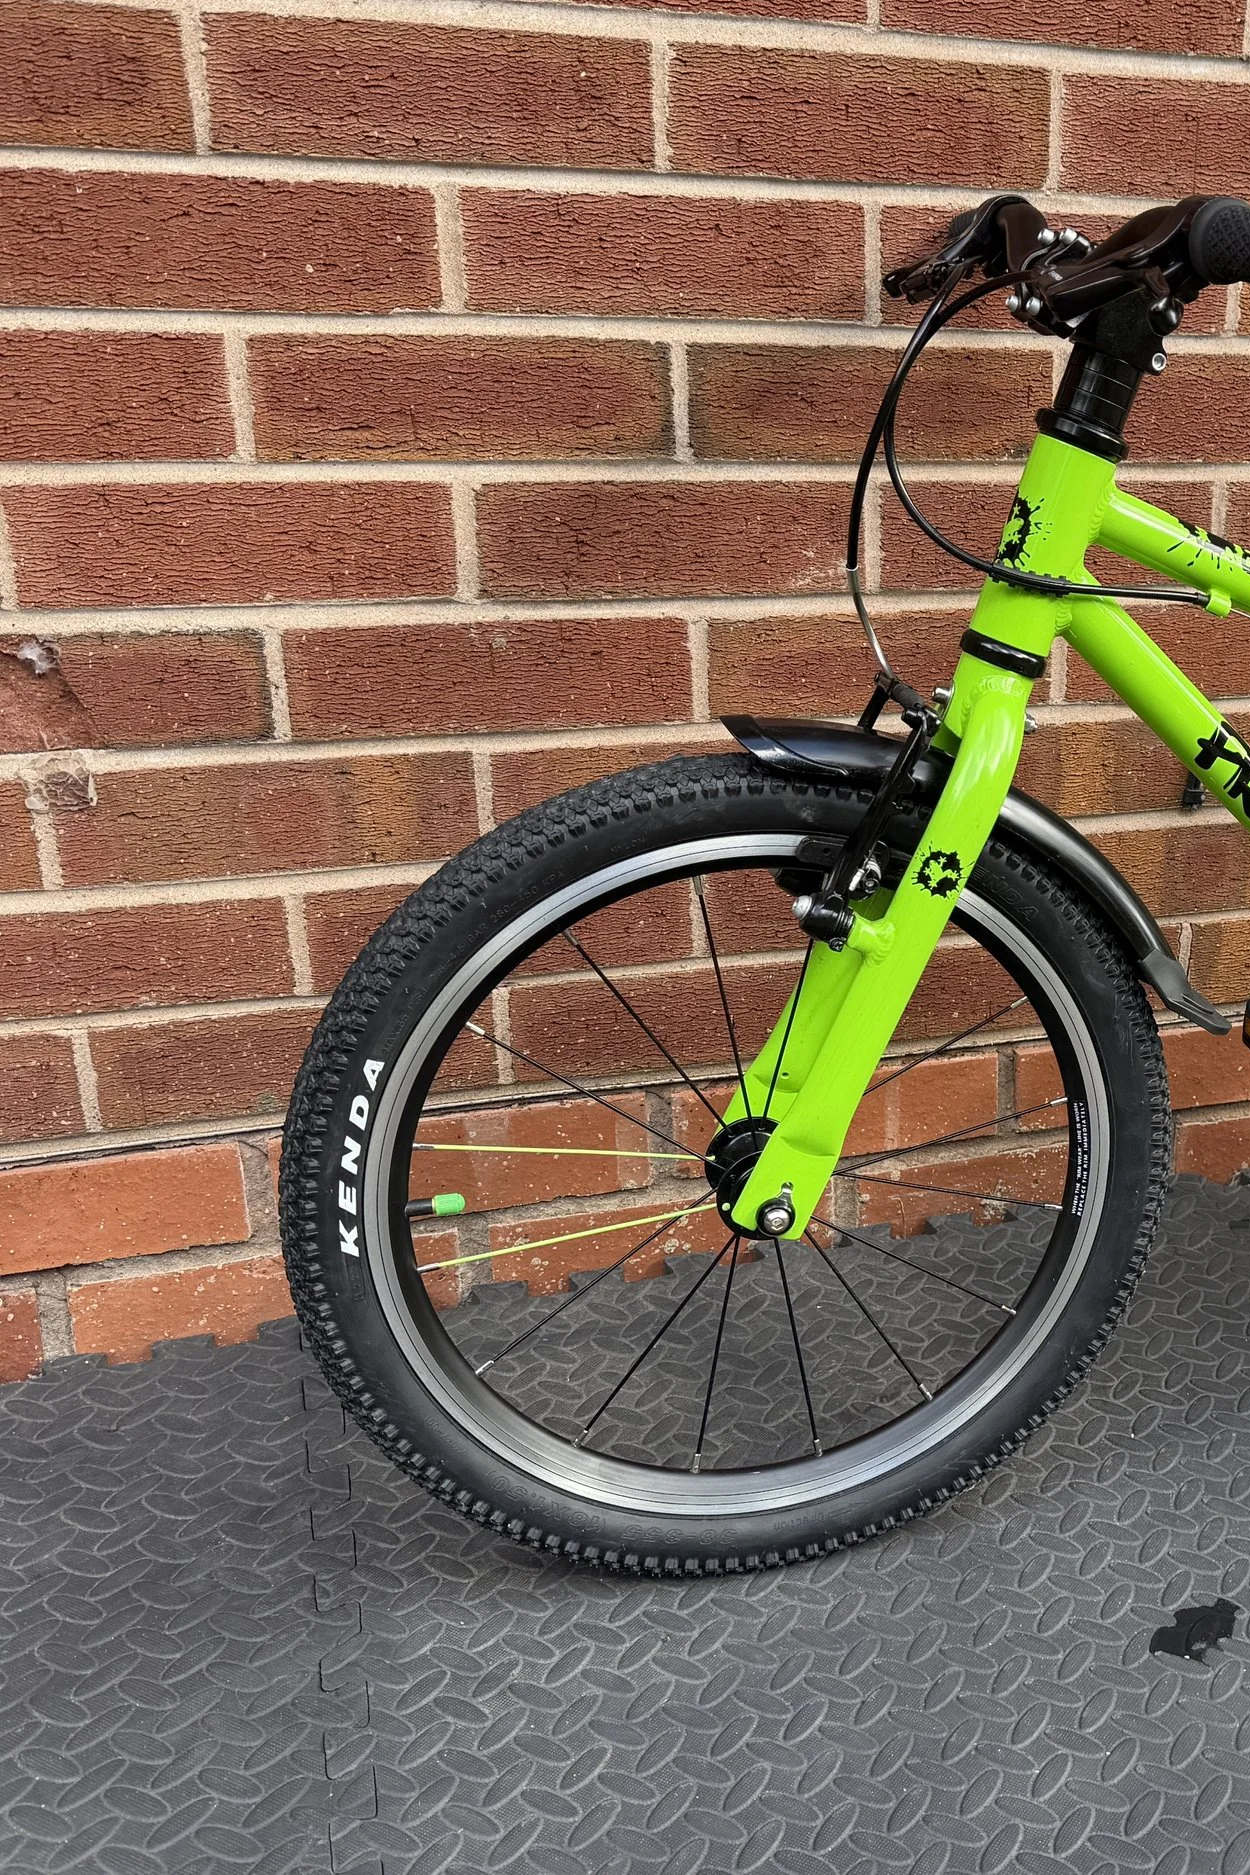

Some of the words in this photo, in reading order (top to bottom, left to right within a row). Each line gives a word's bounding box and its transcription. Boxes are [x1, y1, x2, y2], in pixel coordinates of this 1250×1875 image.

[971, 864, 1040, 922] ENDA
[1073, 1102, 1081, 1122] WORN
[1078, 1102, 1089, 1151] IMMEDIATELY
[338, 1058, 385, 1258] KENDA
[1071, 1194, 1080, 1214] WHEN
[1076, 1185, 1087, 1217] REPLACE
[621, 1523, 738, 1546] 38-355
